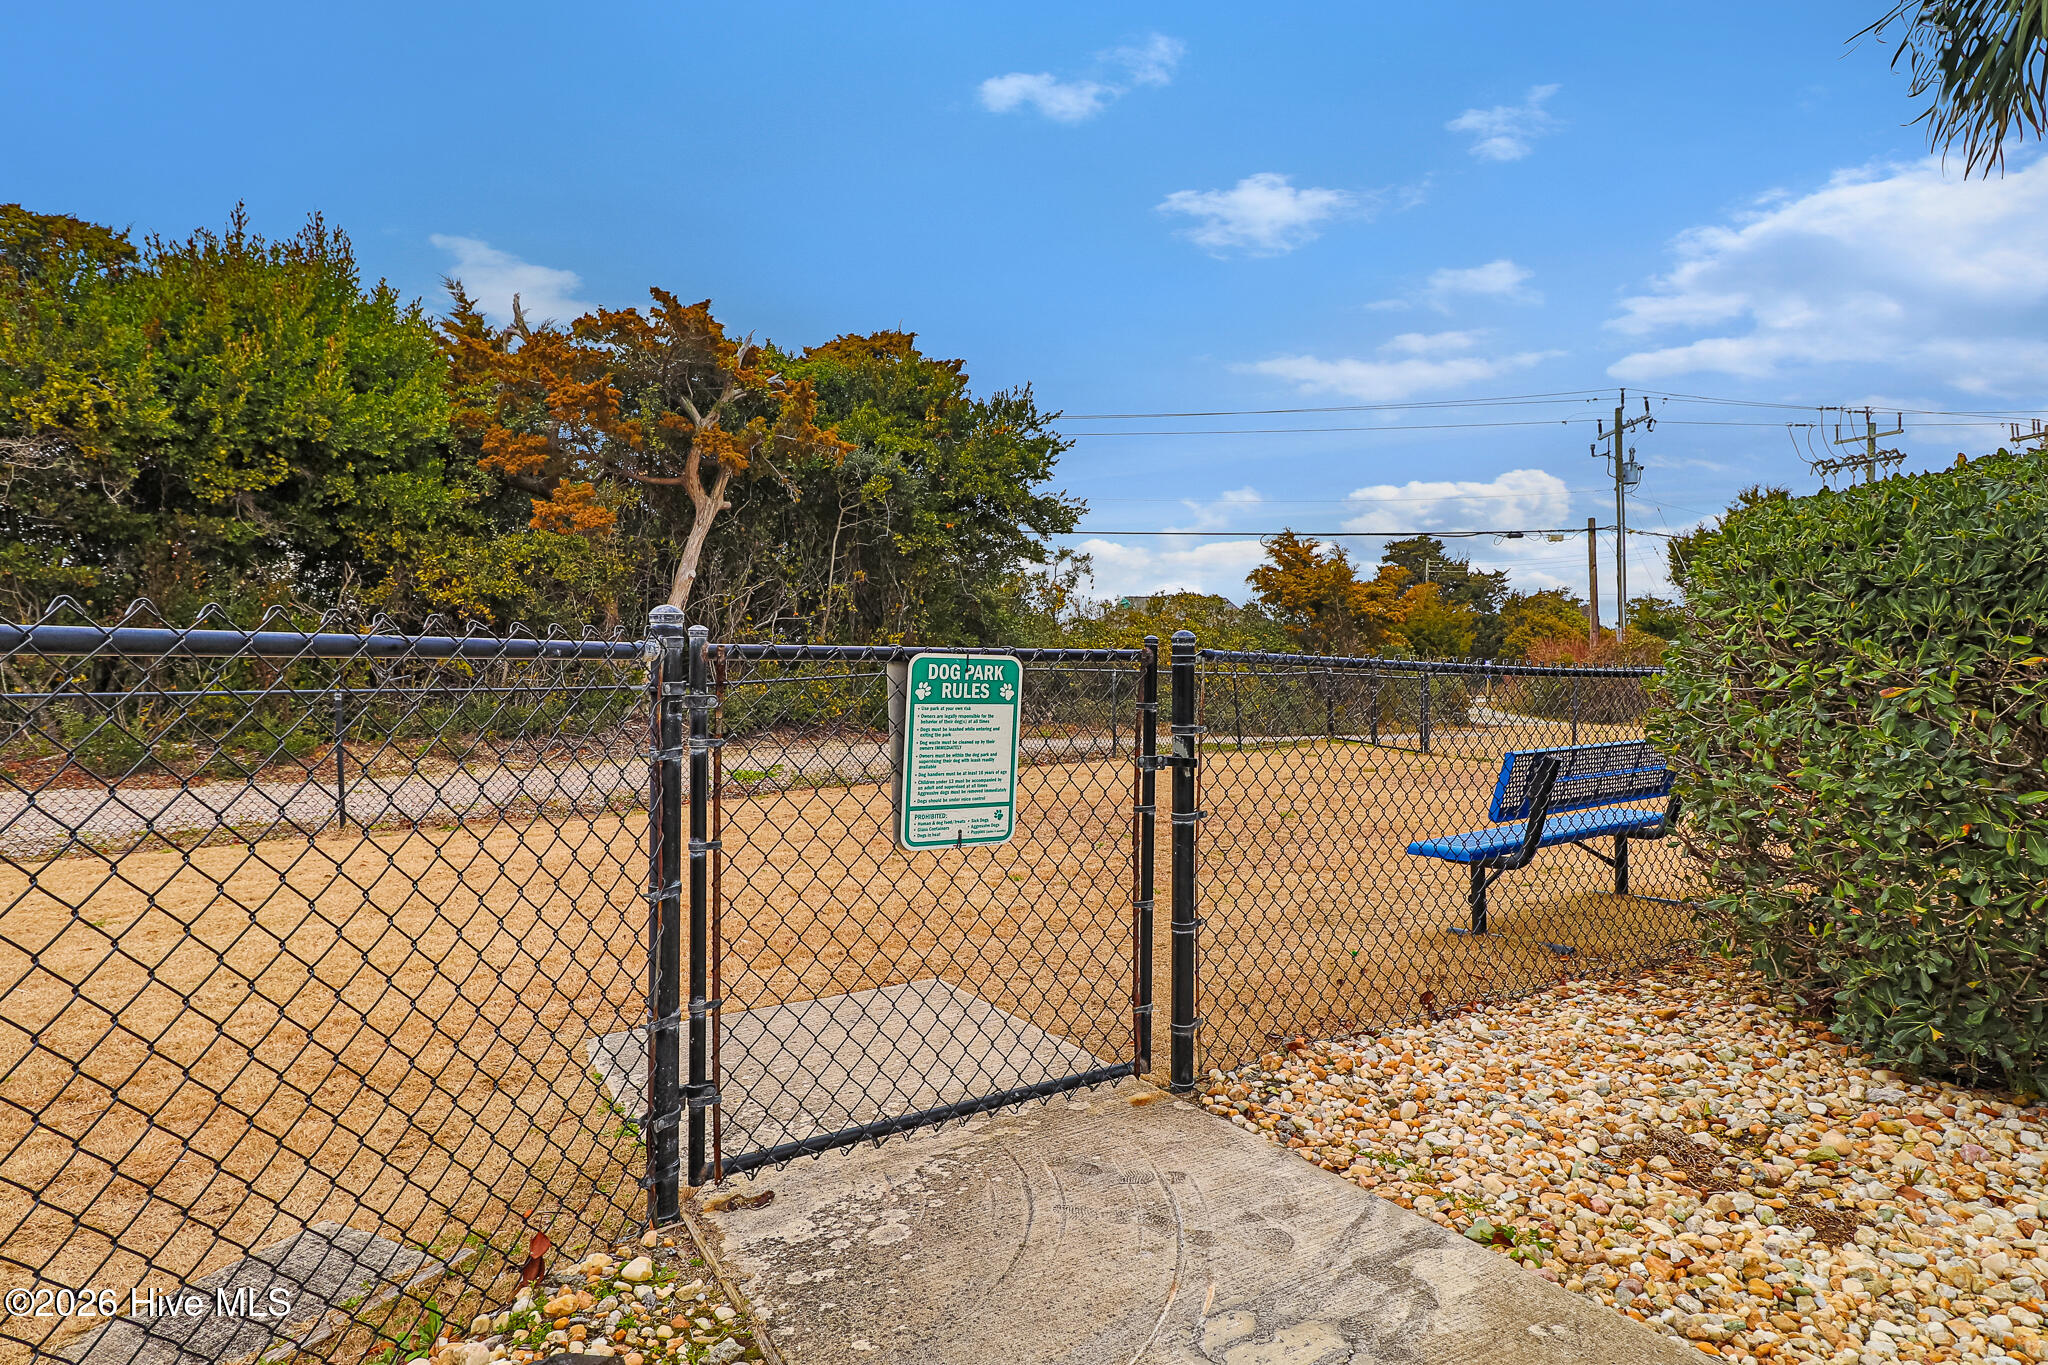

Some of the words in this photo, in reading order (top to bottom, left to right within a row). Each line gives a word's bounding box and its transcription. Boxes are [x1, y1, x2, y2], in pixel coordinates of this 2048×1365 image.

[928, 664, 960, 679] DOG
[965, 665, 1004, 680] PARK
[942, 683, 989, 698] RULES
